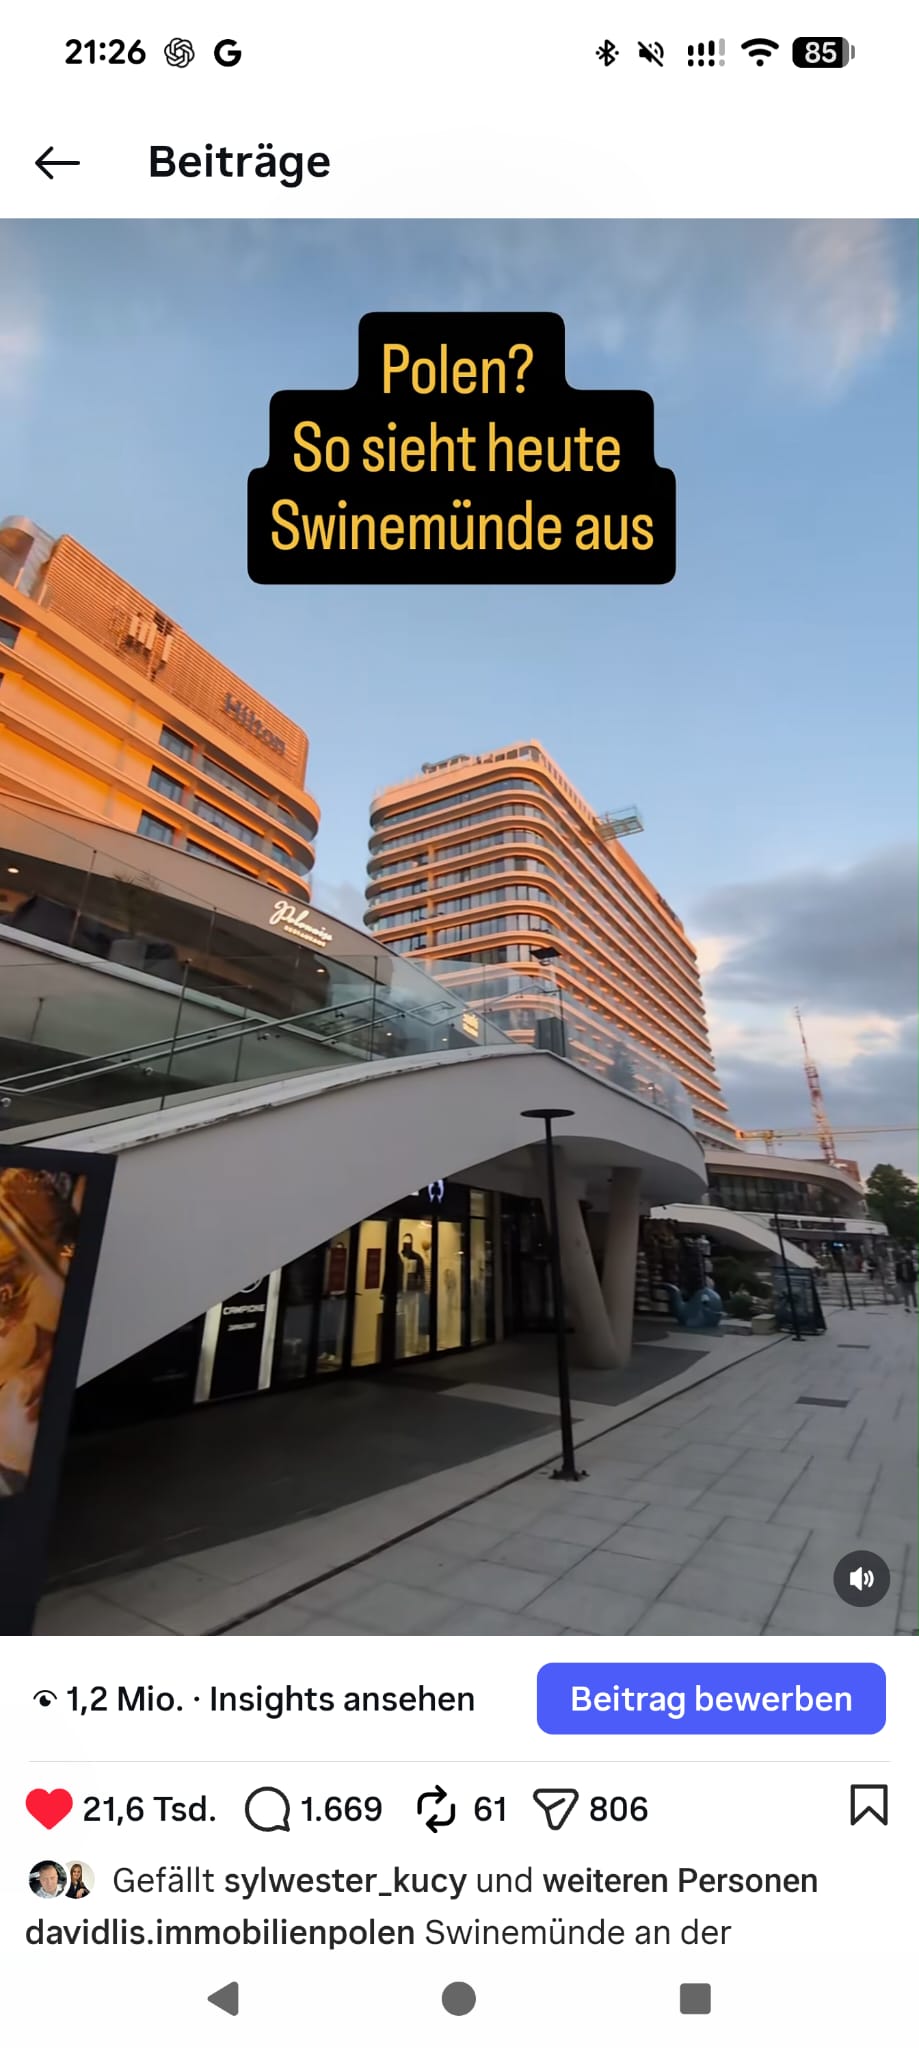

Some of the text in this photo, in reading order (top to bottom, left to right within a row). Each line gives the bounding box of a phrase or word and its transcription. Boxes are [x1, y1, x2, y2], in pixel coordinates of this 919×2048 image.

[66, 39, 146, 64] 21:26
[805, 42, 837, 63] 85
[150, 143, 331, 188] Beiträge
[224, 691, 286, 756] Hilton
[66, 1685, 107, 1715] 1,2
[119, 1685, 183, 1711] Mio.
[211, 1685, 335, 1719] Insights
[343, 1685, 475, 1711] ansehen
[572, 1685, 852, 1719] Beitrag bewerben
[83, 1795, 216, 1826] 21,6 Tsd.
[301, 1796, 382, 1821] 1.669
[474, 1796, 505, 1821] 61
[590, 1796, 648, 1821] 806
[113, 1866, 818, 1900] Gefällt sylwester_kucy und weiteren Personen
[25, 1917, 732, 1949] davidlis.immobilienpolen Swinemünde an der
